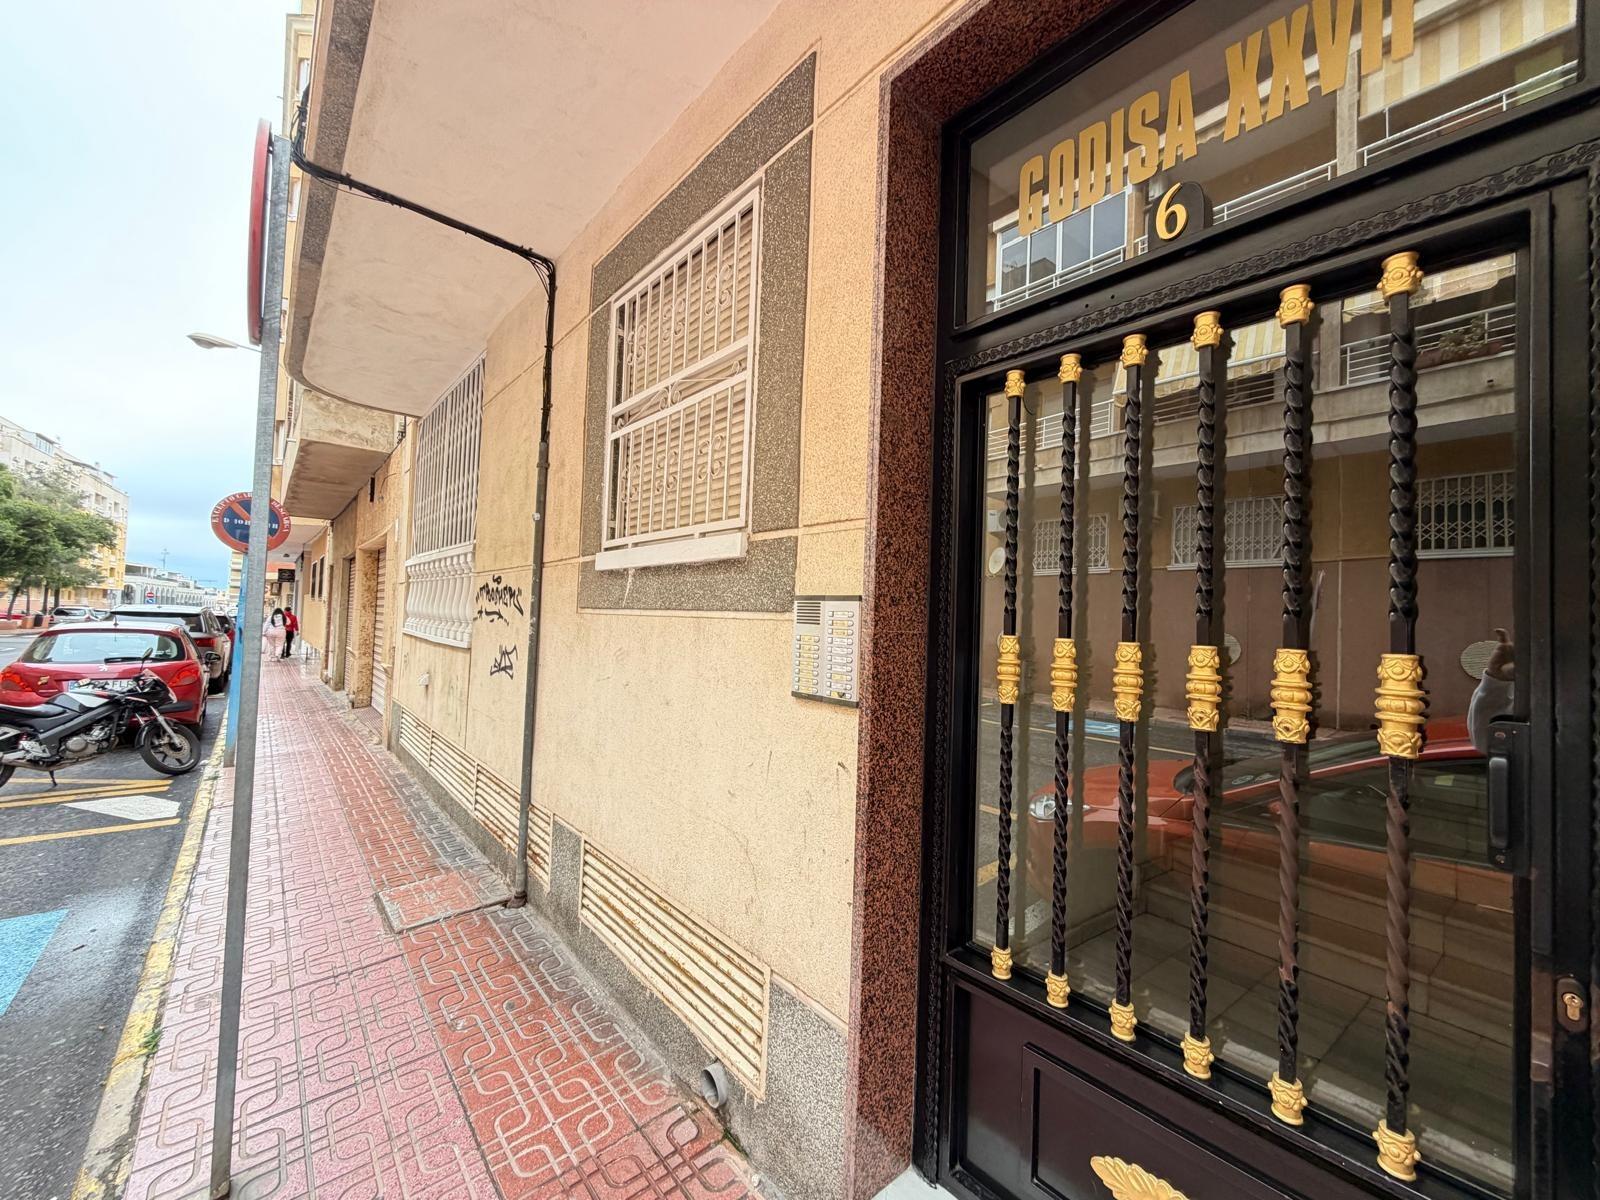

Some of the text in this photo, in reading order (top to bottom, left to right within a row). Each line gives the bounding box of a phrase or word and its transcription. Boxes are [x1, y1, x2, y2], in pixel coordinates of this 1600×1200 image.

[1018, 0, 1414, 238] GODISA XXVII
[1155, 182, 1189, 241] 6
